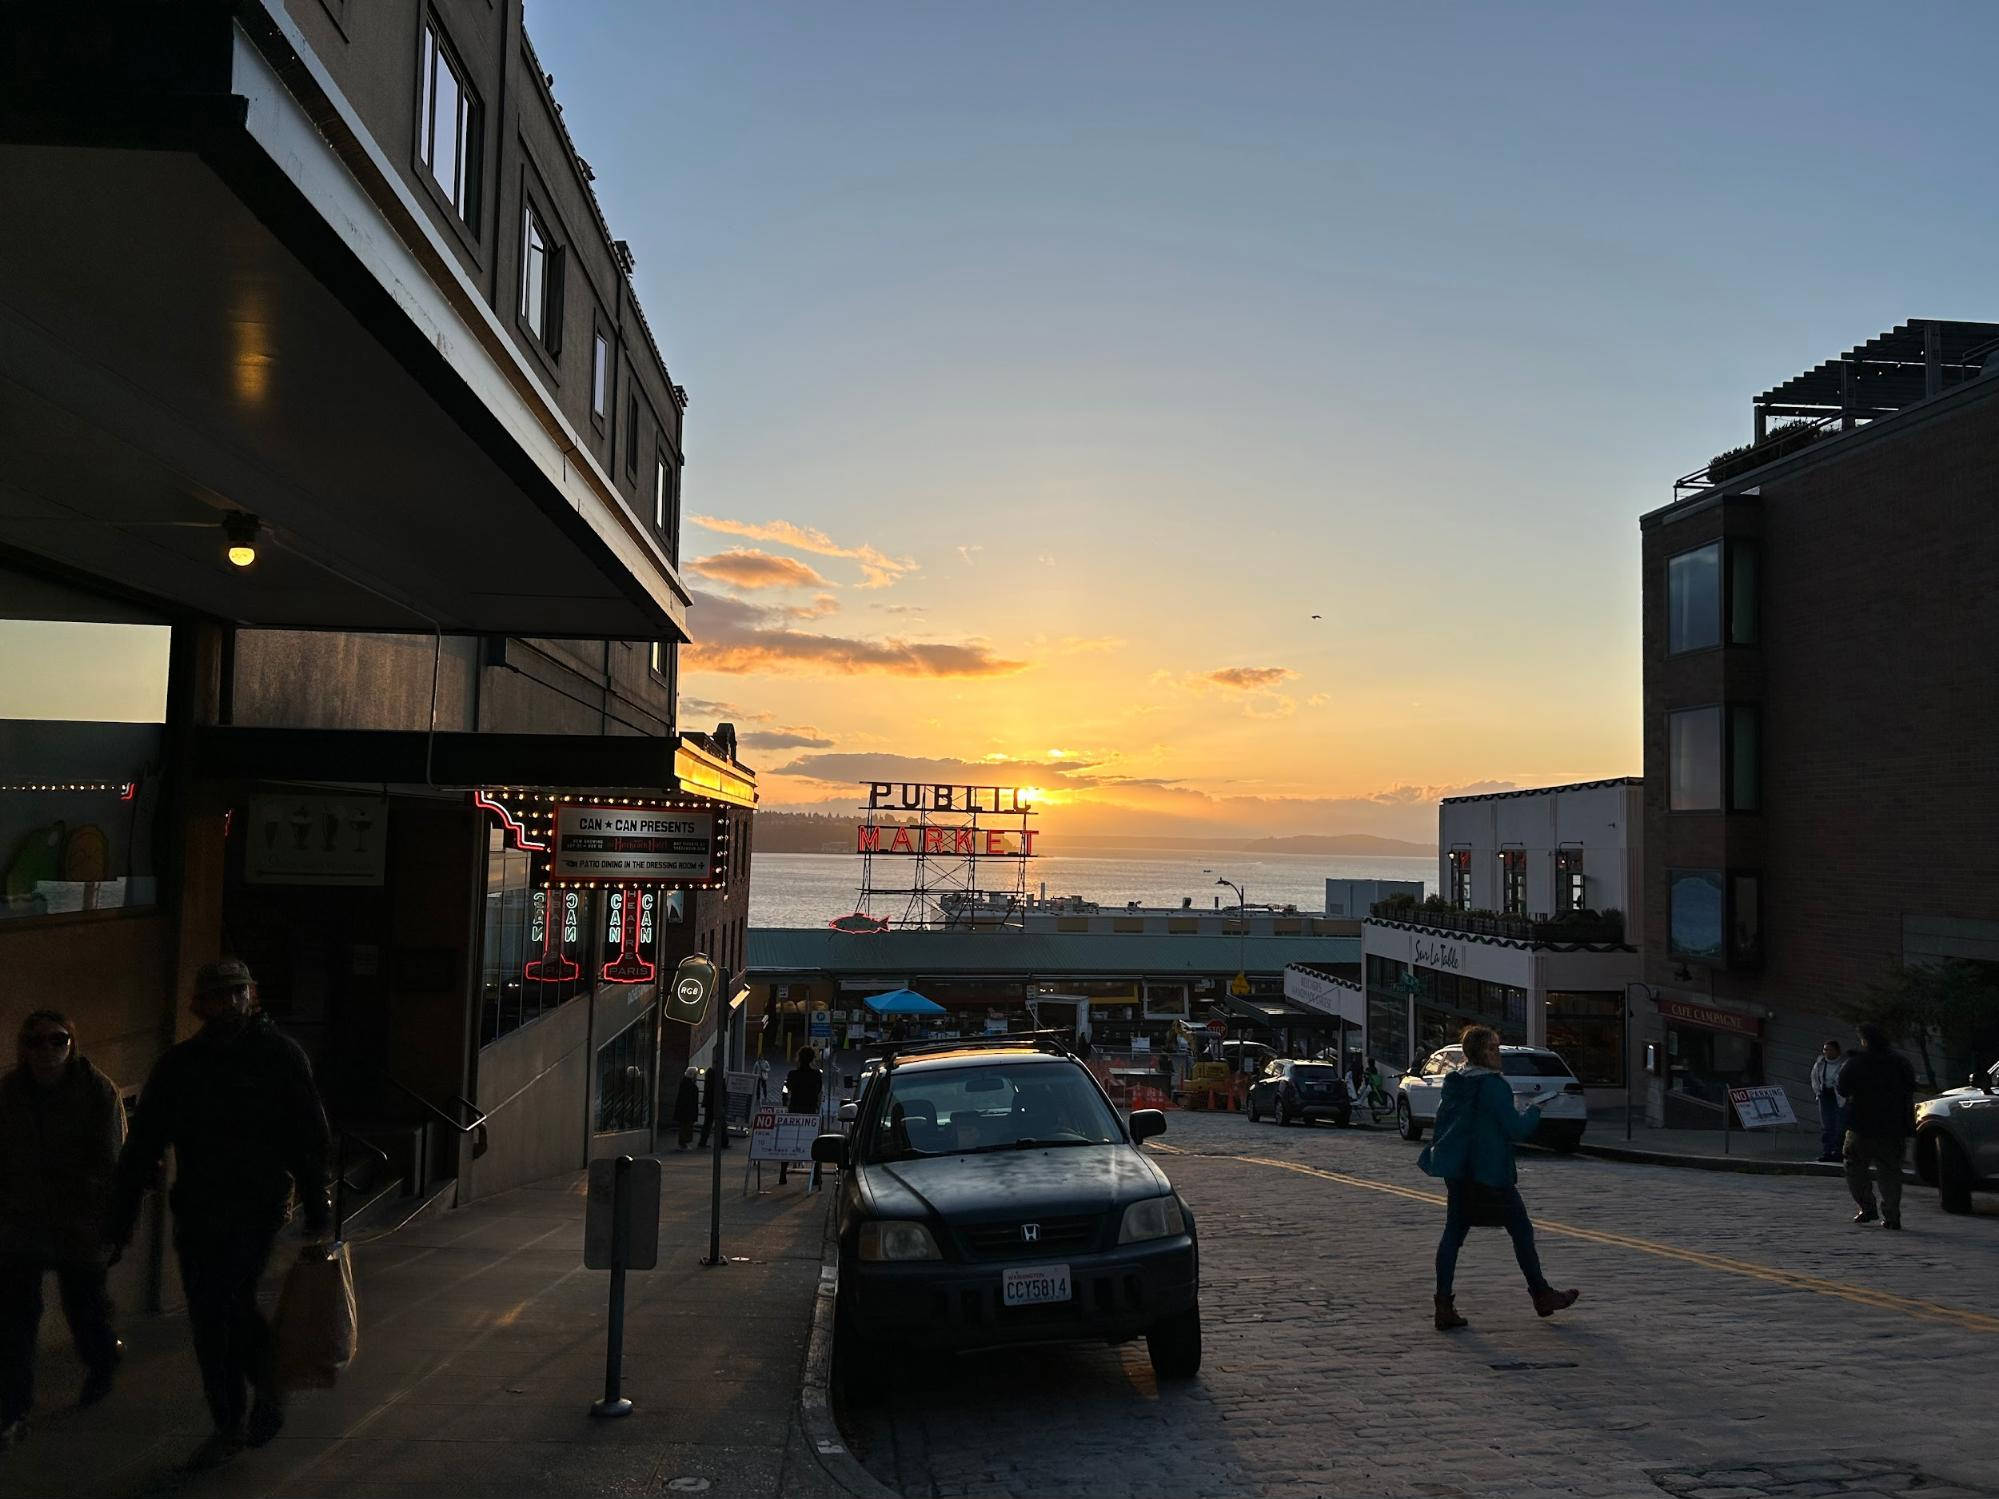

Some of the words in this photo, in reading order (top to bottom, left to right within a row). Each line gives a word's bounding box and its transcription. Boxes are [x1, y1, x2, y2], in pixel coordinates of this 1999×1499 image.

[871, 783, 1031, 812] PUBLIC
[580, 818, 602, 831] CAN
[615, 820, 637, 832] CAN
[640, 821, 695, 833] PRESENTS
[857, 826, 1039, 855] MARKET
[579, 860, 599, 868] PATIO
[601, 860, 623, 868] DINING
[646, 861, 677, 869] DRESSING
[678, 861, 697, 869] ROOM
[609, 893, 623, 943] CAN
[625, 890, 636, 960] HEATRE
[640, 894, 654, 943] CAN
[1415, 939, 1430, 962] Sur
[1430, 942, 1440, 965] La
[1440, 944, 1458, 969] Table
[608, 967, 649, 976] PARIS
[680, 986, 699, 995] RGB
[1733, 1091, 1748, 1102] NO
[756, 1115, 772, 1128] NO
[777, 1116, 817, 1128] PARKING
[1007, 1278, 1066, 1300] CCY5814
